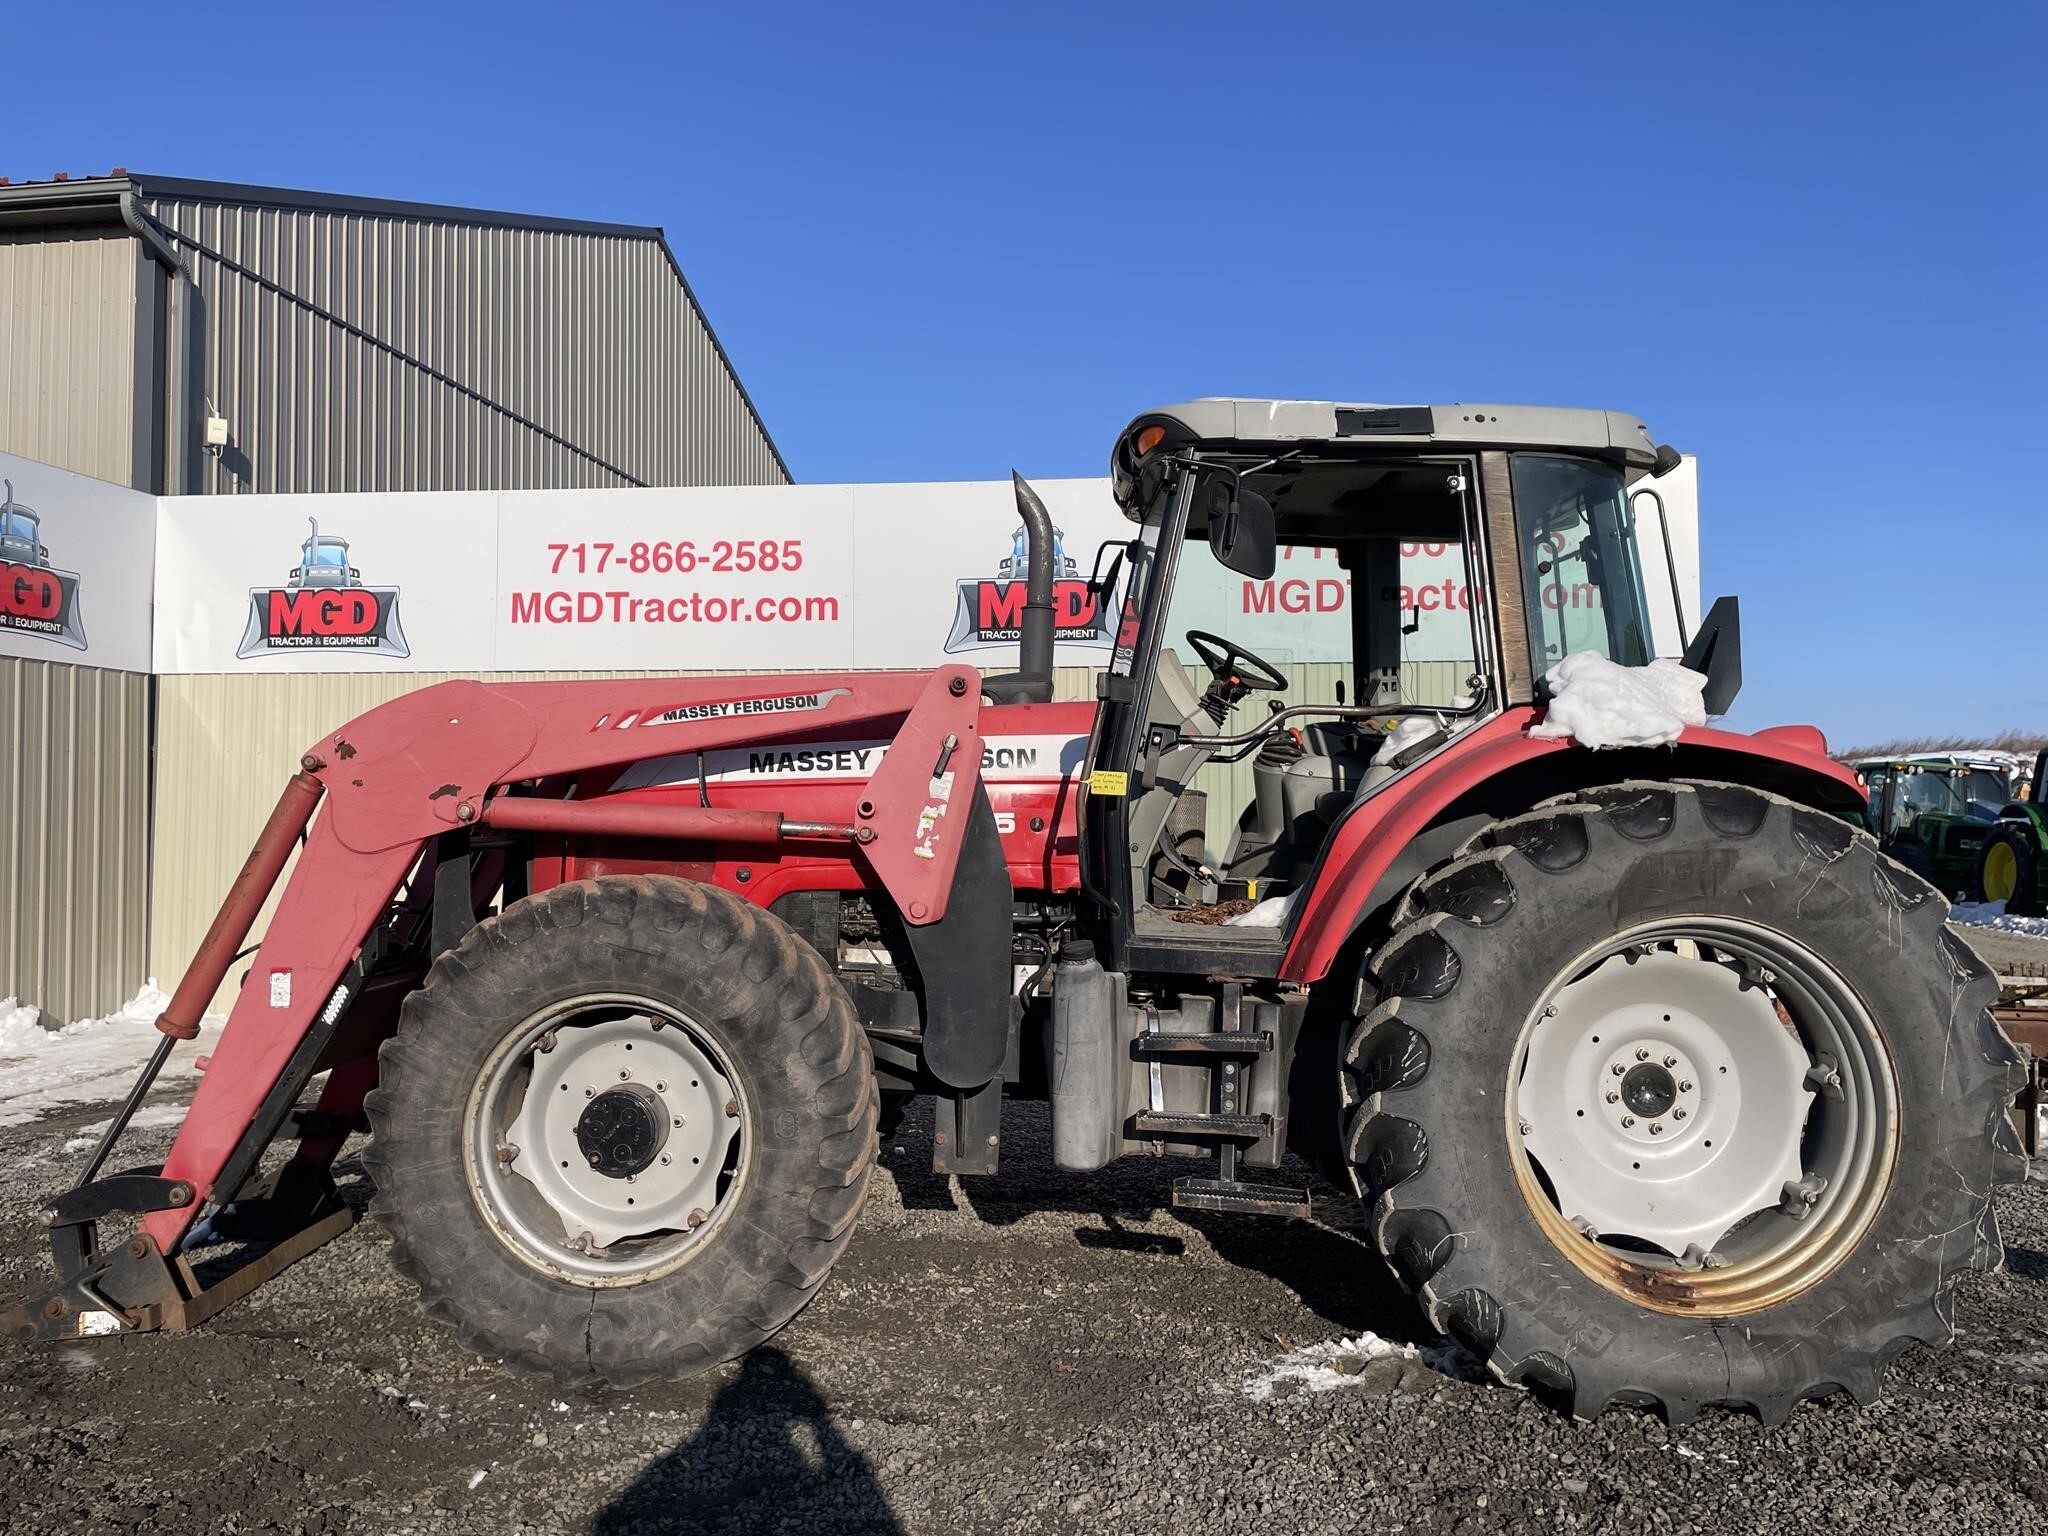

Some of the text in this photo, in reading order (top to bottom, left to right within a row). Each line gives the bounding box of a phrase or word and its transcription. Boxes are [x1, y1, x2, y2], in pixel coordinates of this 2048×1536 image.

[547, 540, 802, 574] 717-866-2585
[0, 562, 63, 619] GD
[979, 581, 1097, 628] MD
[269, 589, 379, 636] MGD
[511, 591, 839, 624] MGDTractor.com
[15, 617, 62, 633] EQUIPMENT
[980, 630, 1021, 640] TRACTO
[270, 636, 377, 646] TRACTOR & EQUIPMENT
[663, 695, 818, 721] MASSEY FERGUSON
[749, 749, 871, 774] MASSEY
